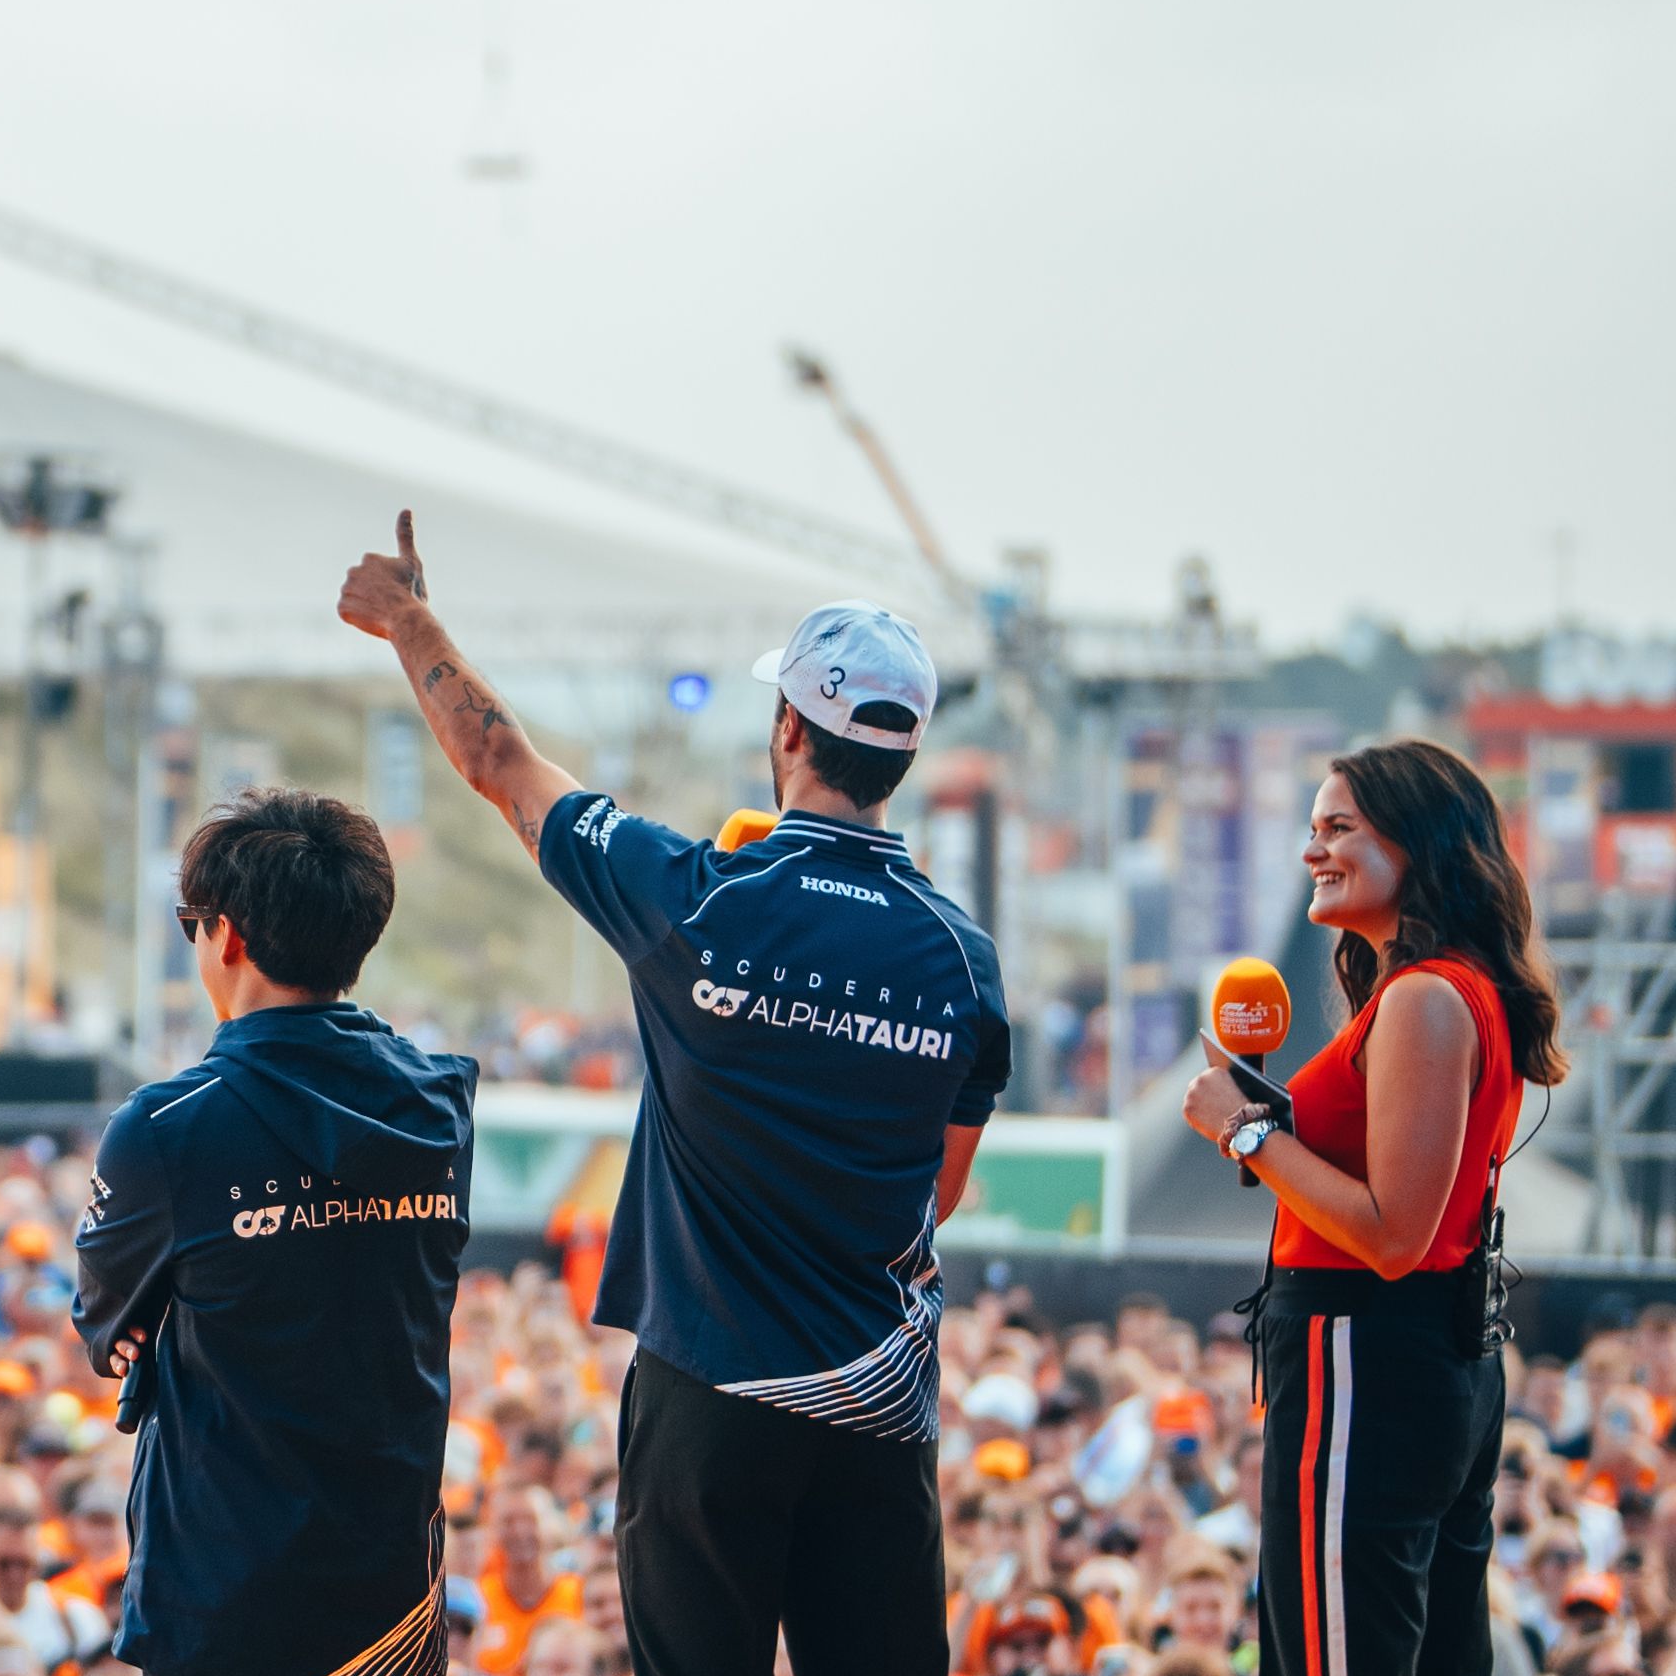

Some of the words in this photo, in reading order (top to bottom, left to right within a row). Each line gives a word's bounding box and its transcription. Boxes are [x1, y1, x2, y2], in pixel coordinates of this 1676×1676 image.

[819, 666, 847, 700] 3
[800, 876, 890, 907] HONDA
[700, 949, 954, 1017] SCUDERIA
[747, 995, 953, 1060] ALPHATAURI
